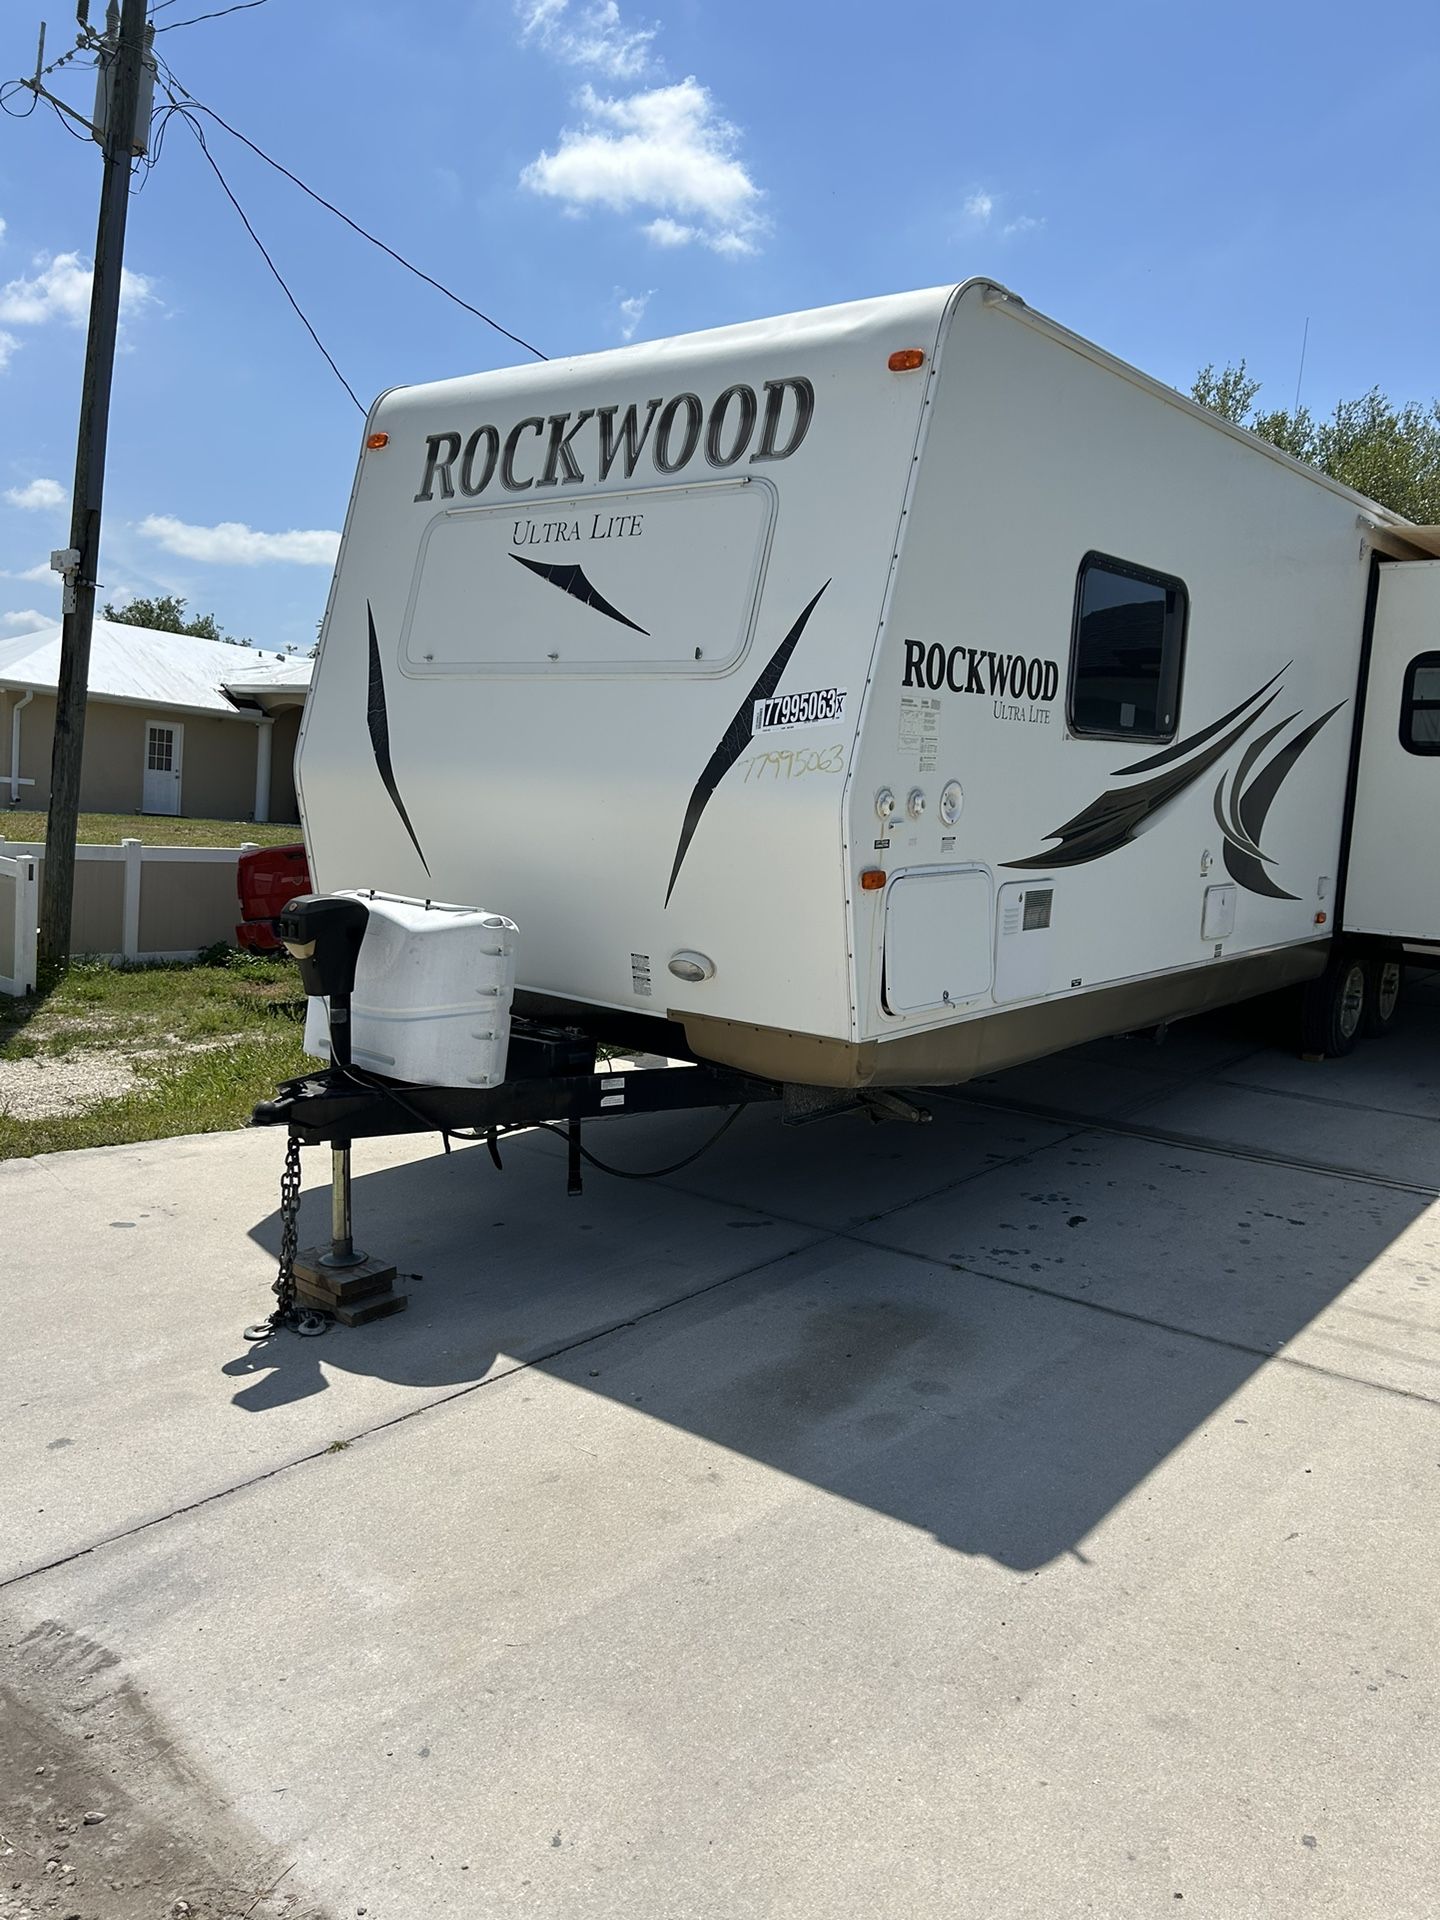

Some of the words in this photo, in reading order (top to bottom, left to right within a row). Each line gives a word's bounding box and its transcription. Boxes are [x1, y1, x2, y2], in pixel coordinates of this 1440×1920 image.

[413, 375, 815, 504] ROCKWOOD
[513, 520, 581, 545] ULTRA
[589, 514, 644, 540] LITE
[902, 638, 1059, 702] ROCKWOOD
[764, 689, 836, 725] 77995063
[992, 699, 1026, 722] ULTRA
[1029, 704, 1051, 725] LITE
[738, 744, 844, 783] 77995063
